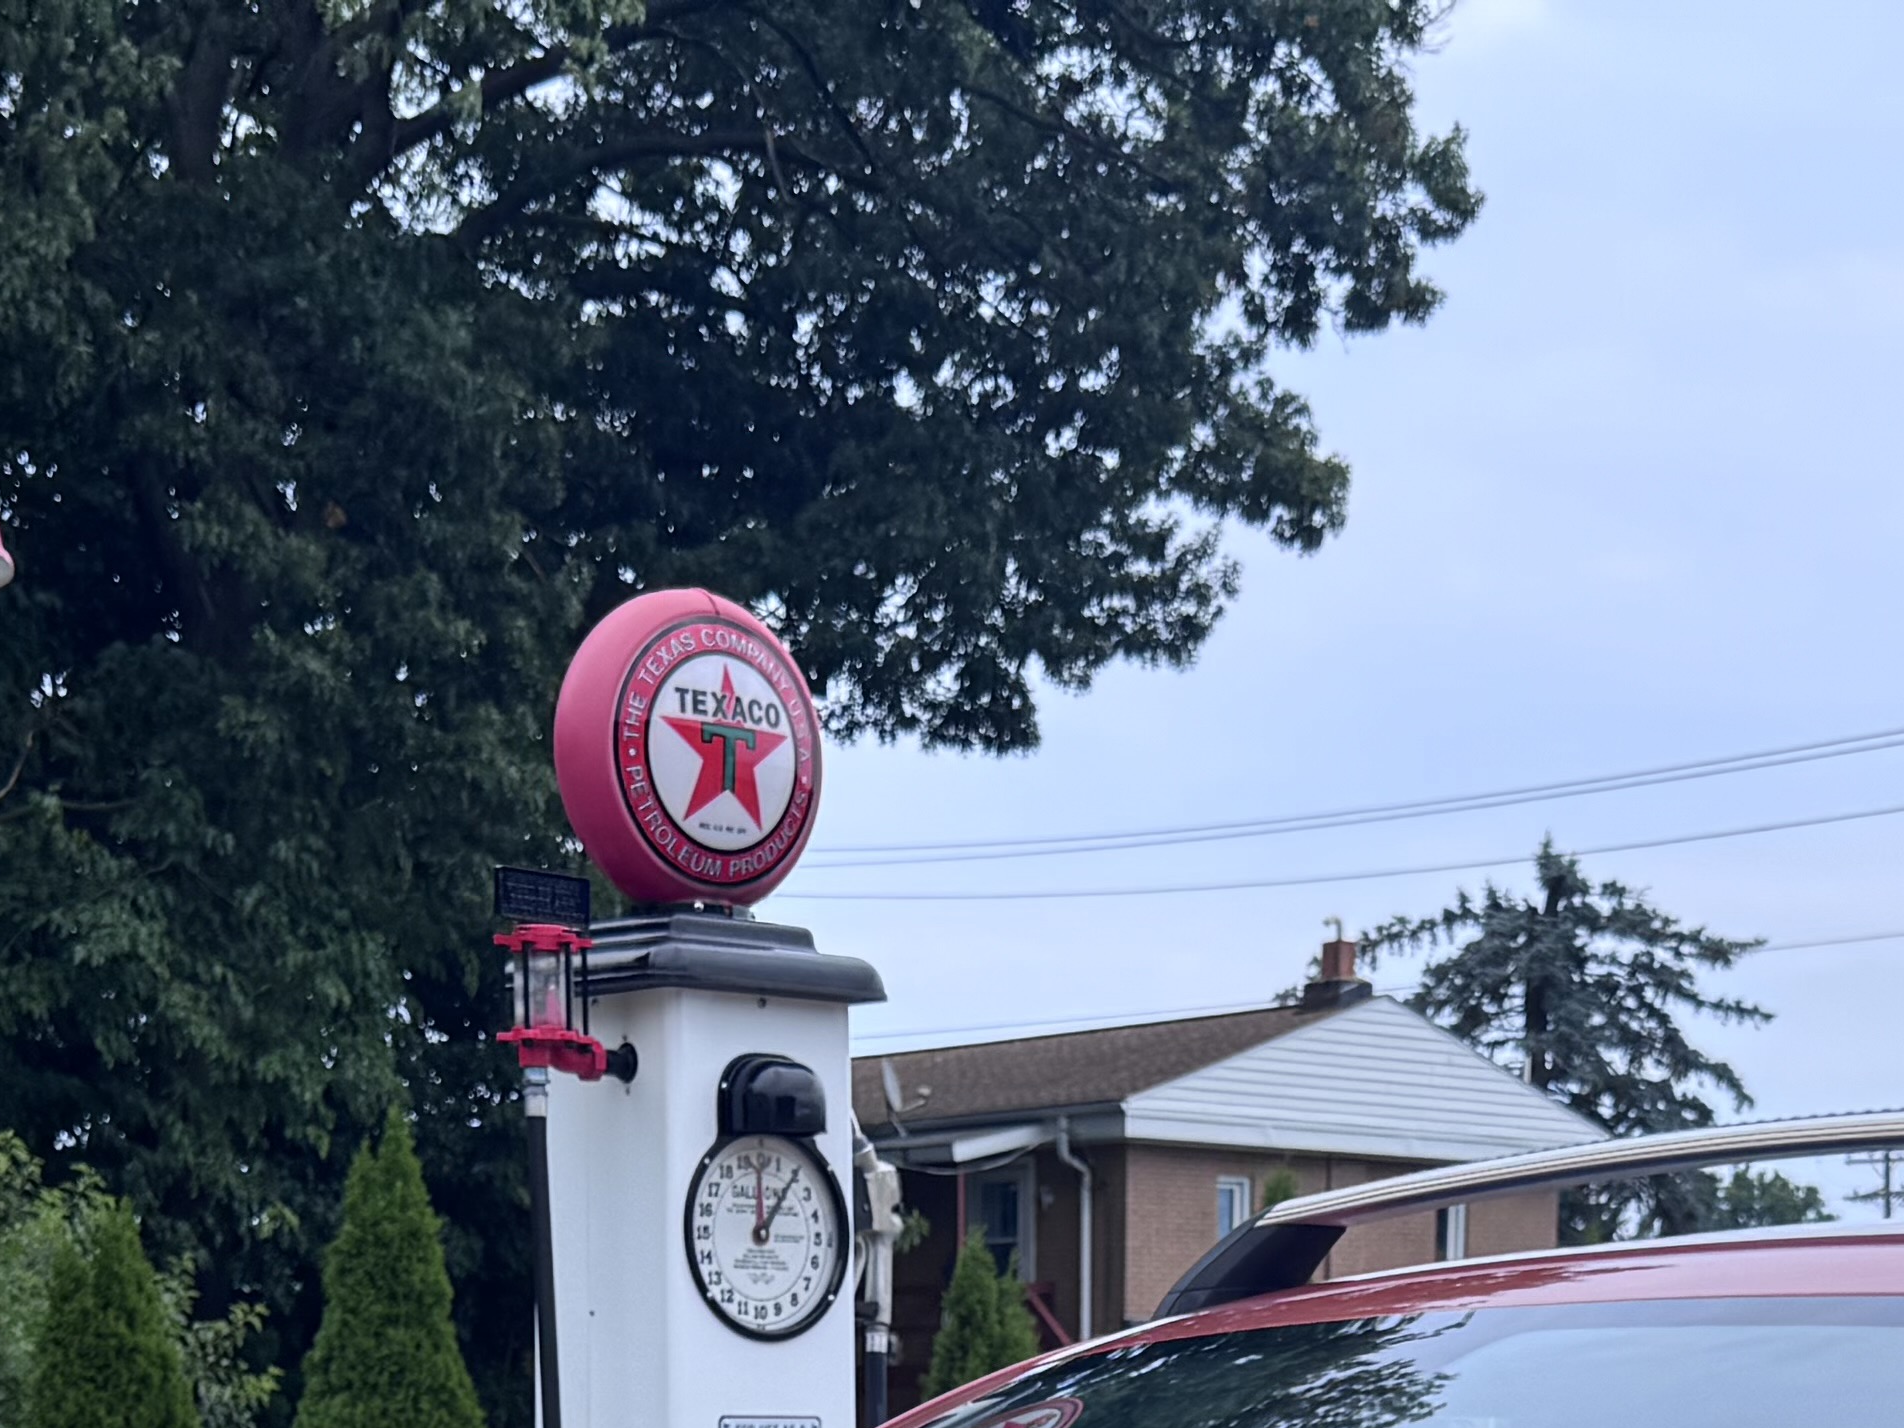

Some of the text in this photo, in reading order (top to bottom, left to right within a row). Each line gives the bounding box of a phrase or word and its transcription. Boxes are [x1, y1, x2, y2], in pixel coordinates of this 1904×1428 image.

[638, 631, 696, 686] TEXAS
[674, 686, 781, 729] TEXACO
[625, 764, 723, 877] PETROLEUM
[708, 1182, 721, 1198] 17
[708, 1271, 722, 1286] 13
[803, 1277, 812, 1292] 7
[720, 1289, 734, 1304] 12
[754, 1305, 768, 1320] 10
